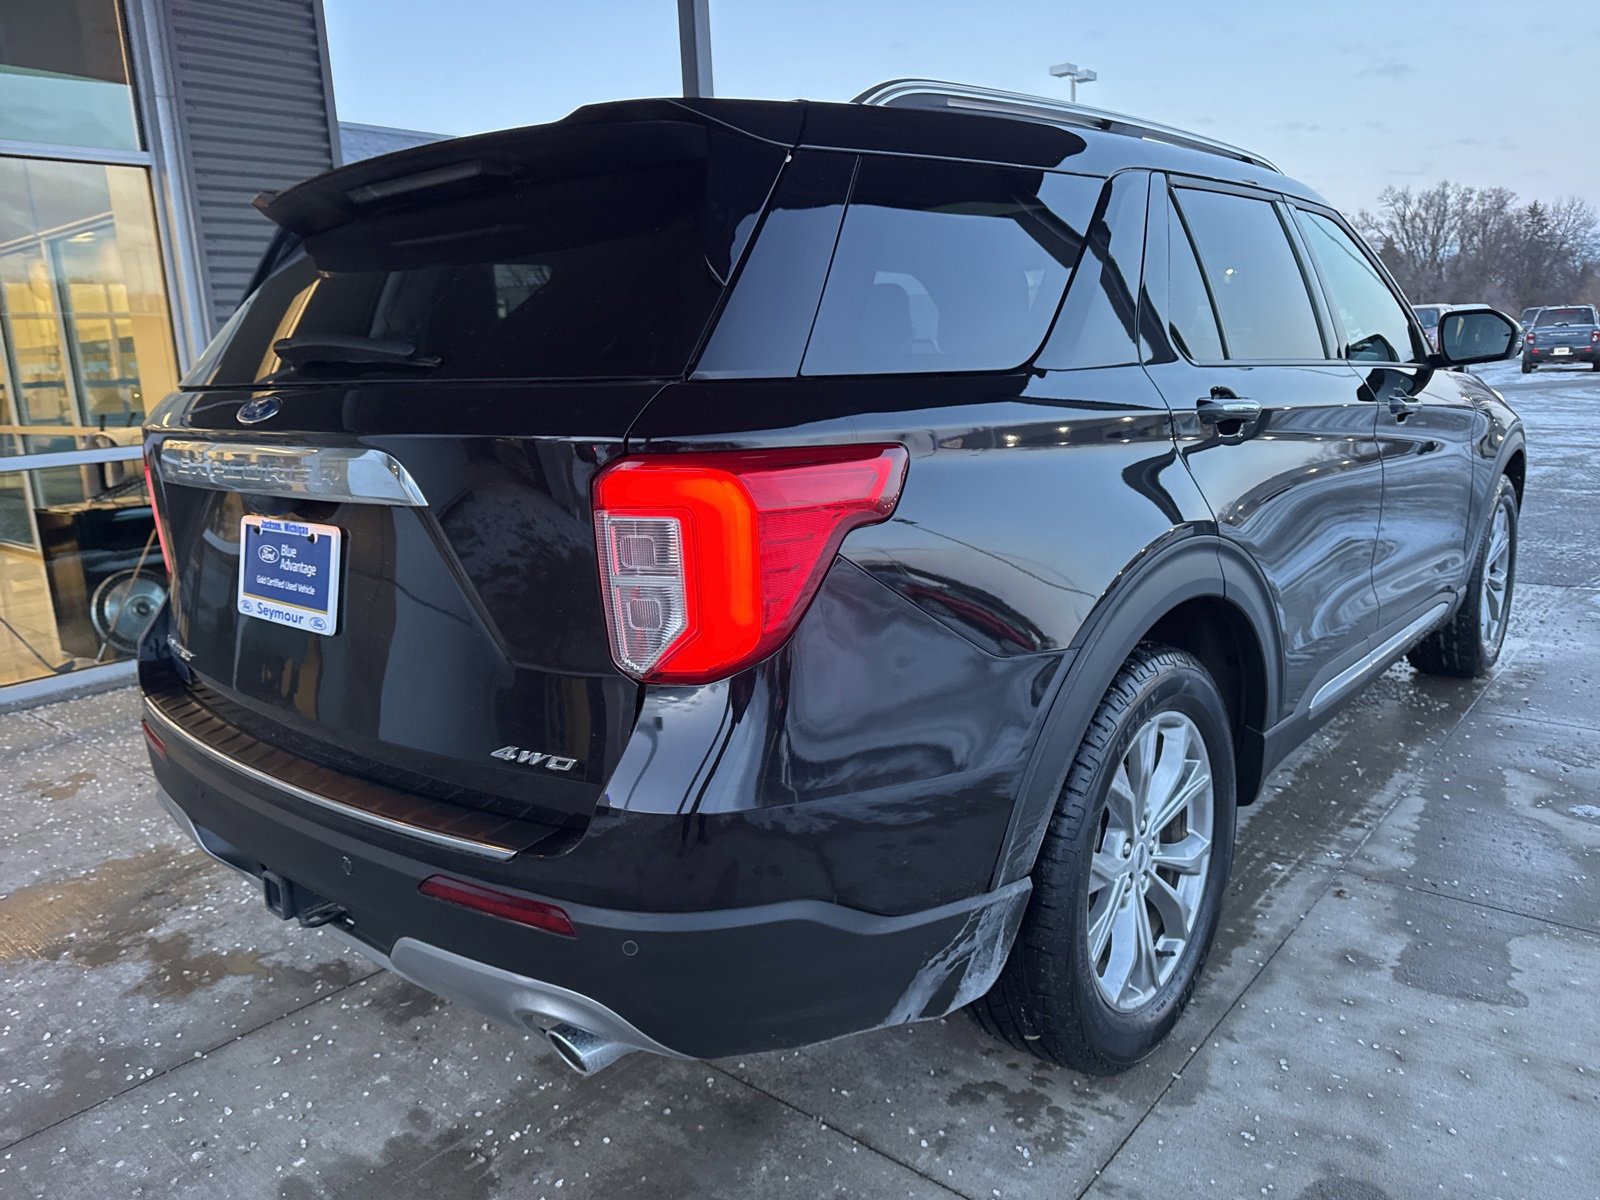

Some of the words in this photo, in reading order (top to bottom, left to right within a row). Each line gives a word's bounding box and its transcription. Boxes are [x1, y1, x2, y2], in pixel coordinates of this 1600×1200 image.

[280, 544, 297, 558] Blue
[280, 559, 317, 577] Advantage
[256, 575, 267, 584] Gold
[267, 578, 284, 589] Certified
[285, 581, 297, 592] Used
[298, 583, 315, 595] Vehicle
[257, 602, 304, 624] Seymour
[490, 746, 577, 771] 4WD
